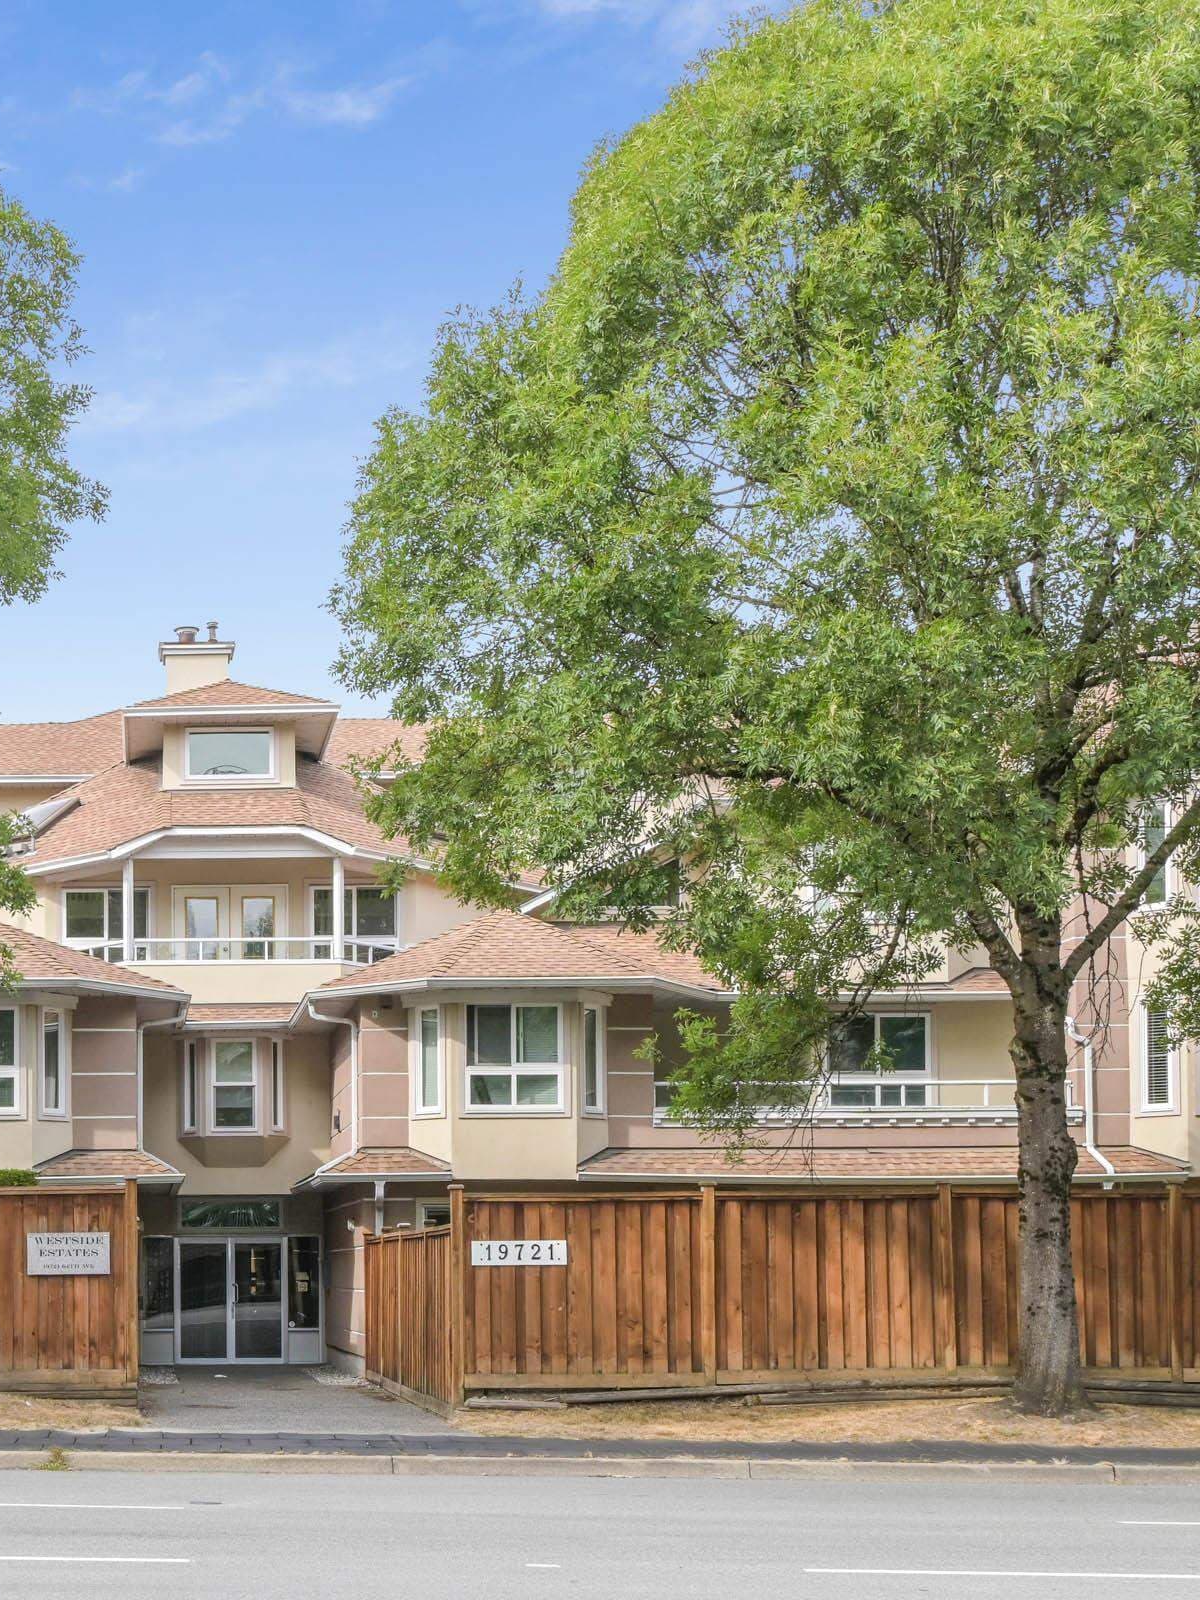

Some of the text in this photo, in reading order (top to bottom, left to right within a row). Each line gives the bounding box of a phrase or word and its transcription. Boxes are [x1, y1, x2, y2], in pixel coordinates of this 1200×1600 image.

[34, 1236, 104, 1245] WESTSIDE
[39, 1248, 99, 1257] ESTATES
[485, 1243, 555, 1261] 19721
